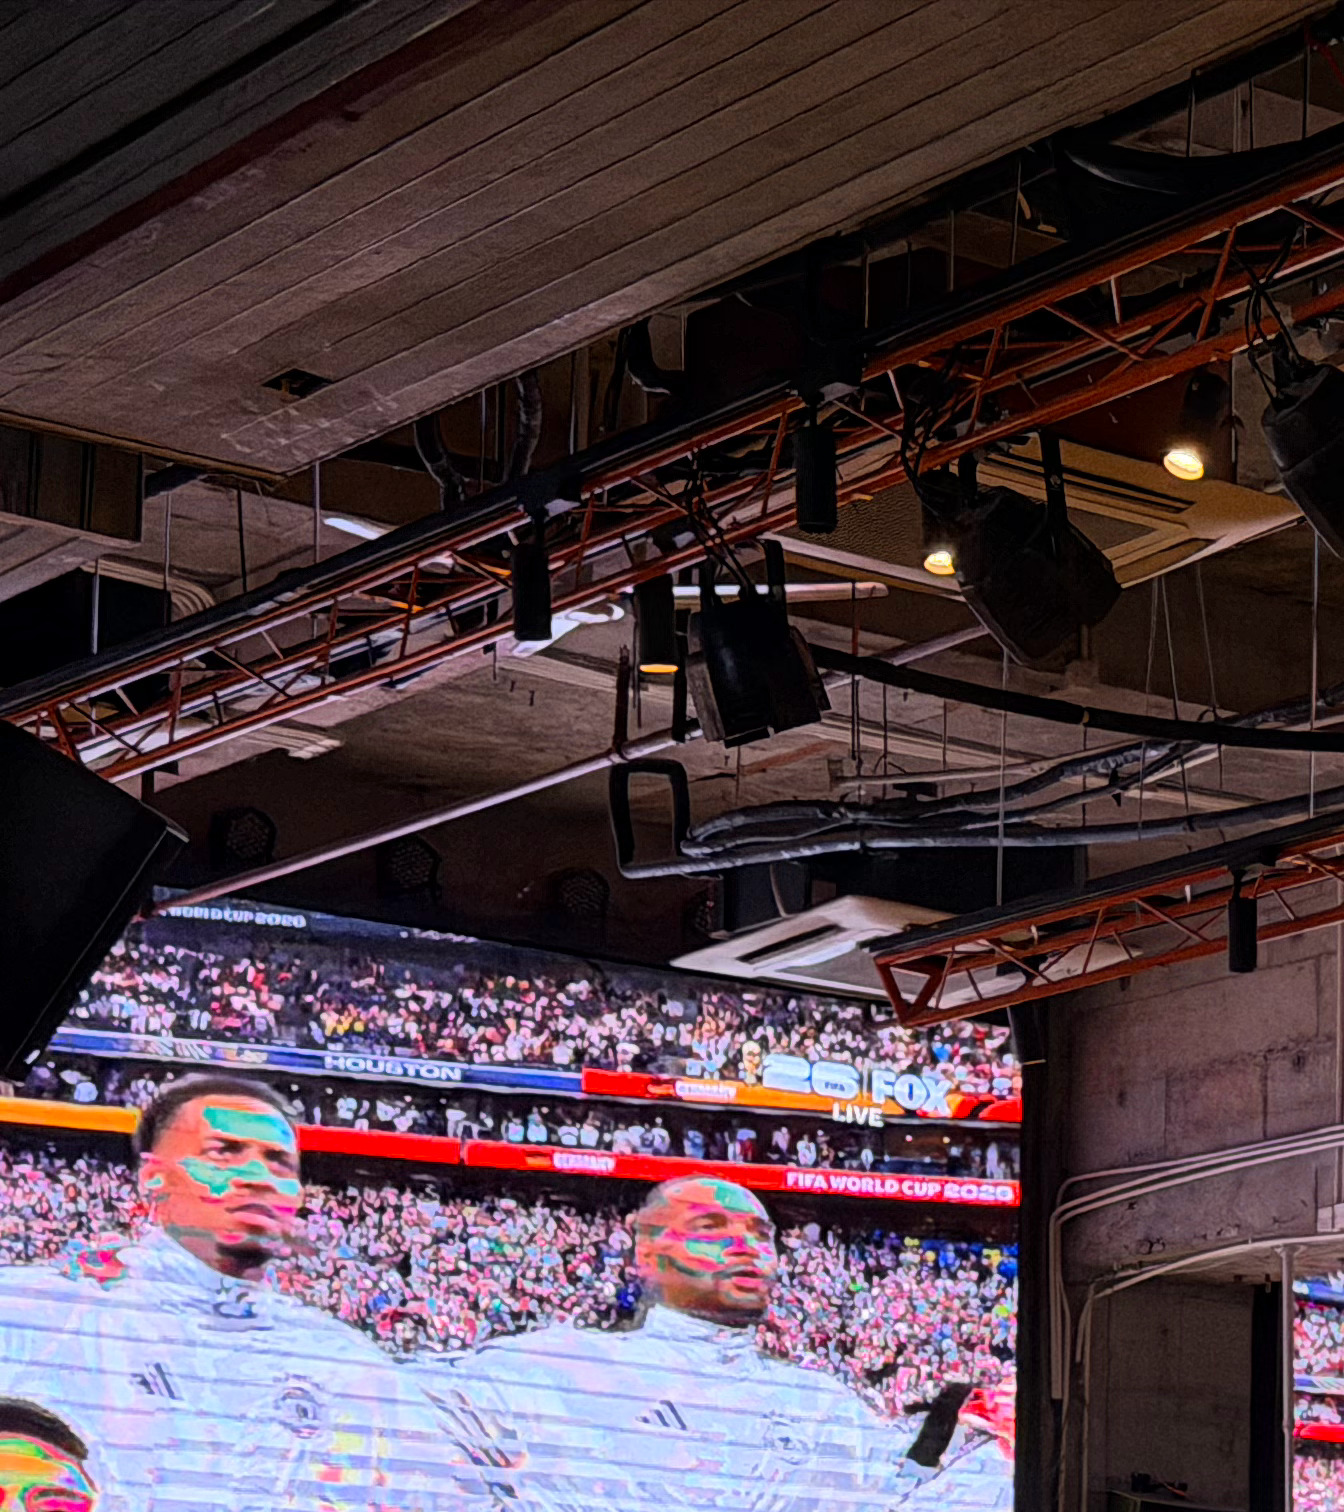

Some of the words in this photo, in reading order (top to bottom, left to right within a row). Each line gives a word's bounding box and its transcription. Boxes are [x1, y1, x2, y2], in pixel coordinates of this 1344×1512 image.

[324, 1054, 462, 1081] HOUSTON
[763, 1054, 860, 1100] 26
[871, 1069, 952, 1118] FOX
[832, 1102, 885, 1128] LIVE
[786, 1171, 828, 1190] FIFA
[829, 1175, 900, 1194] WORLD
[901, 1180, 942, 1198] CUP
